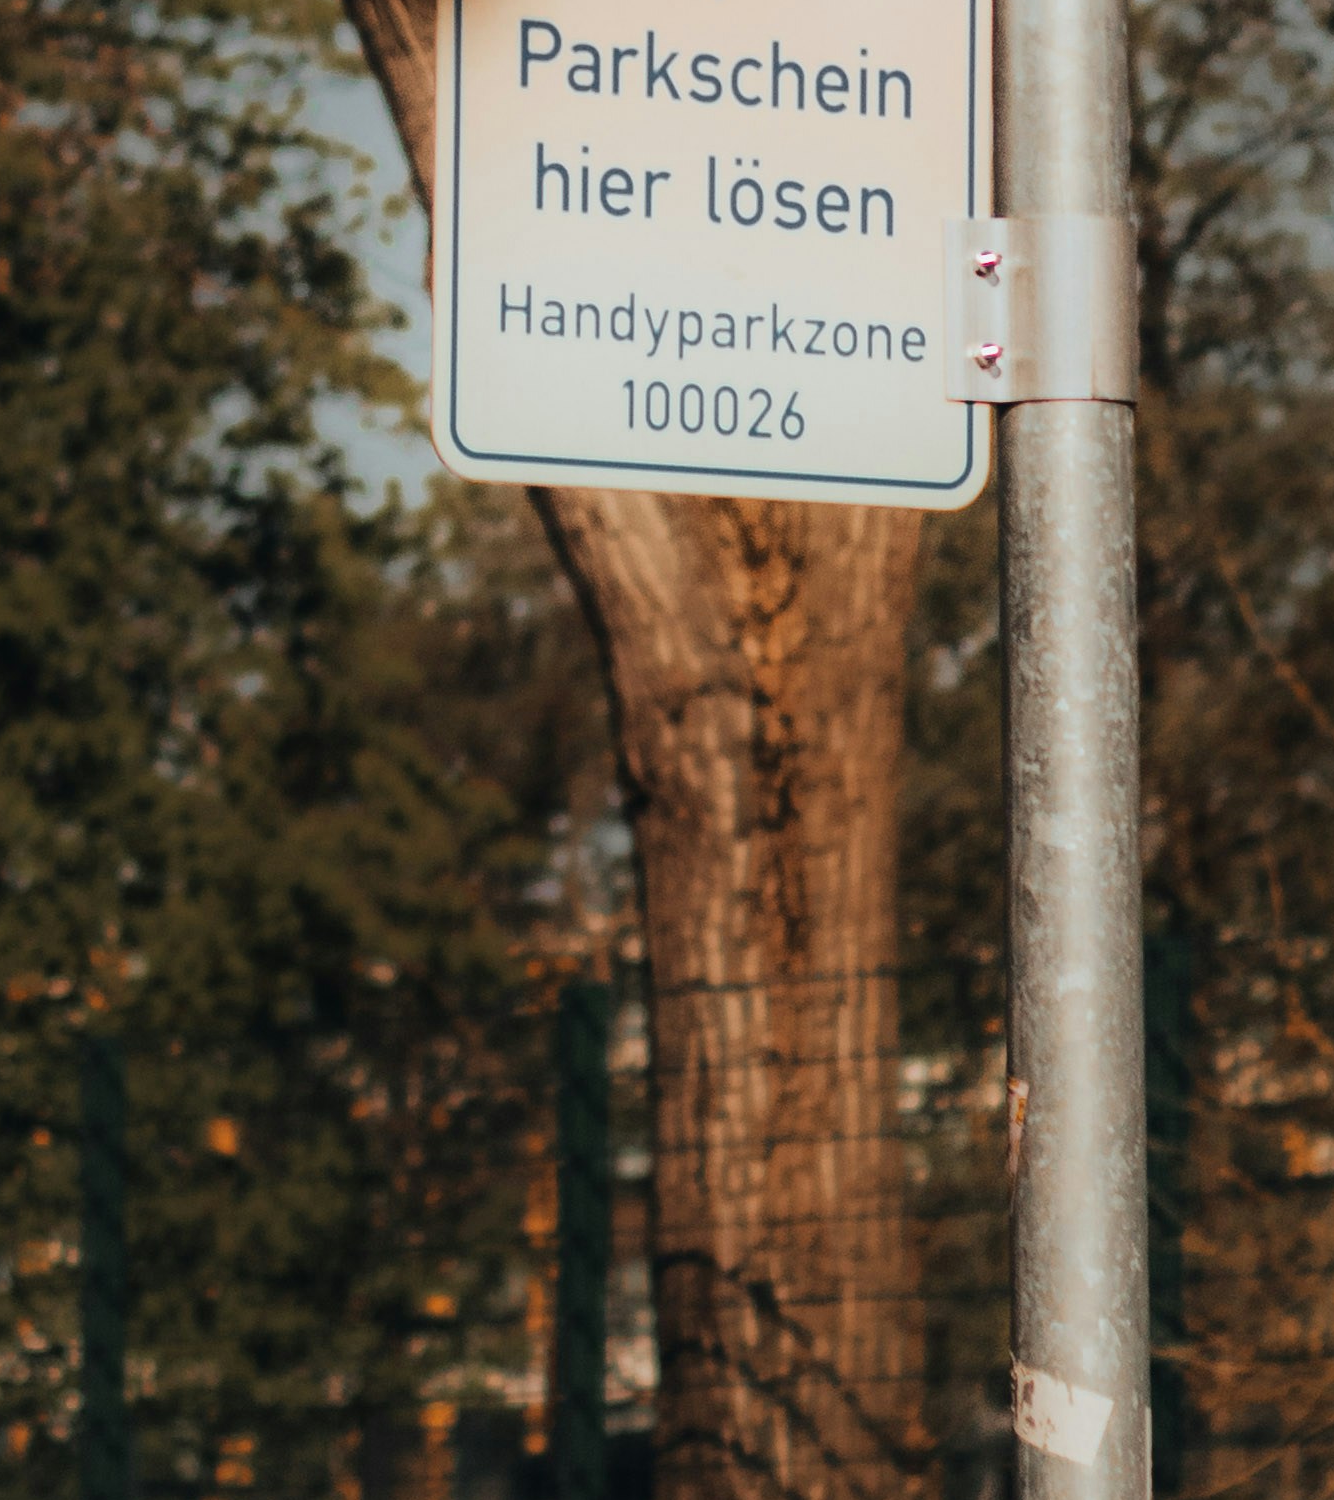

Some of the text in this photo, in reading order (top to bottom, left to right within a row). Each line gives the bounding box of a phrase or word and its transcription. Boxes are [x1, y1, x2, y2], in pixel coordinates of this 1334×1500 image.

[517, 17, 913, 119] Parkschein
[533, 142, 896, 237] hier lösen
[497, 281, 928, 363] Handyparkzone
[621, 378, 807, 441] 100026
